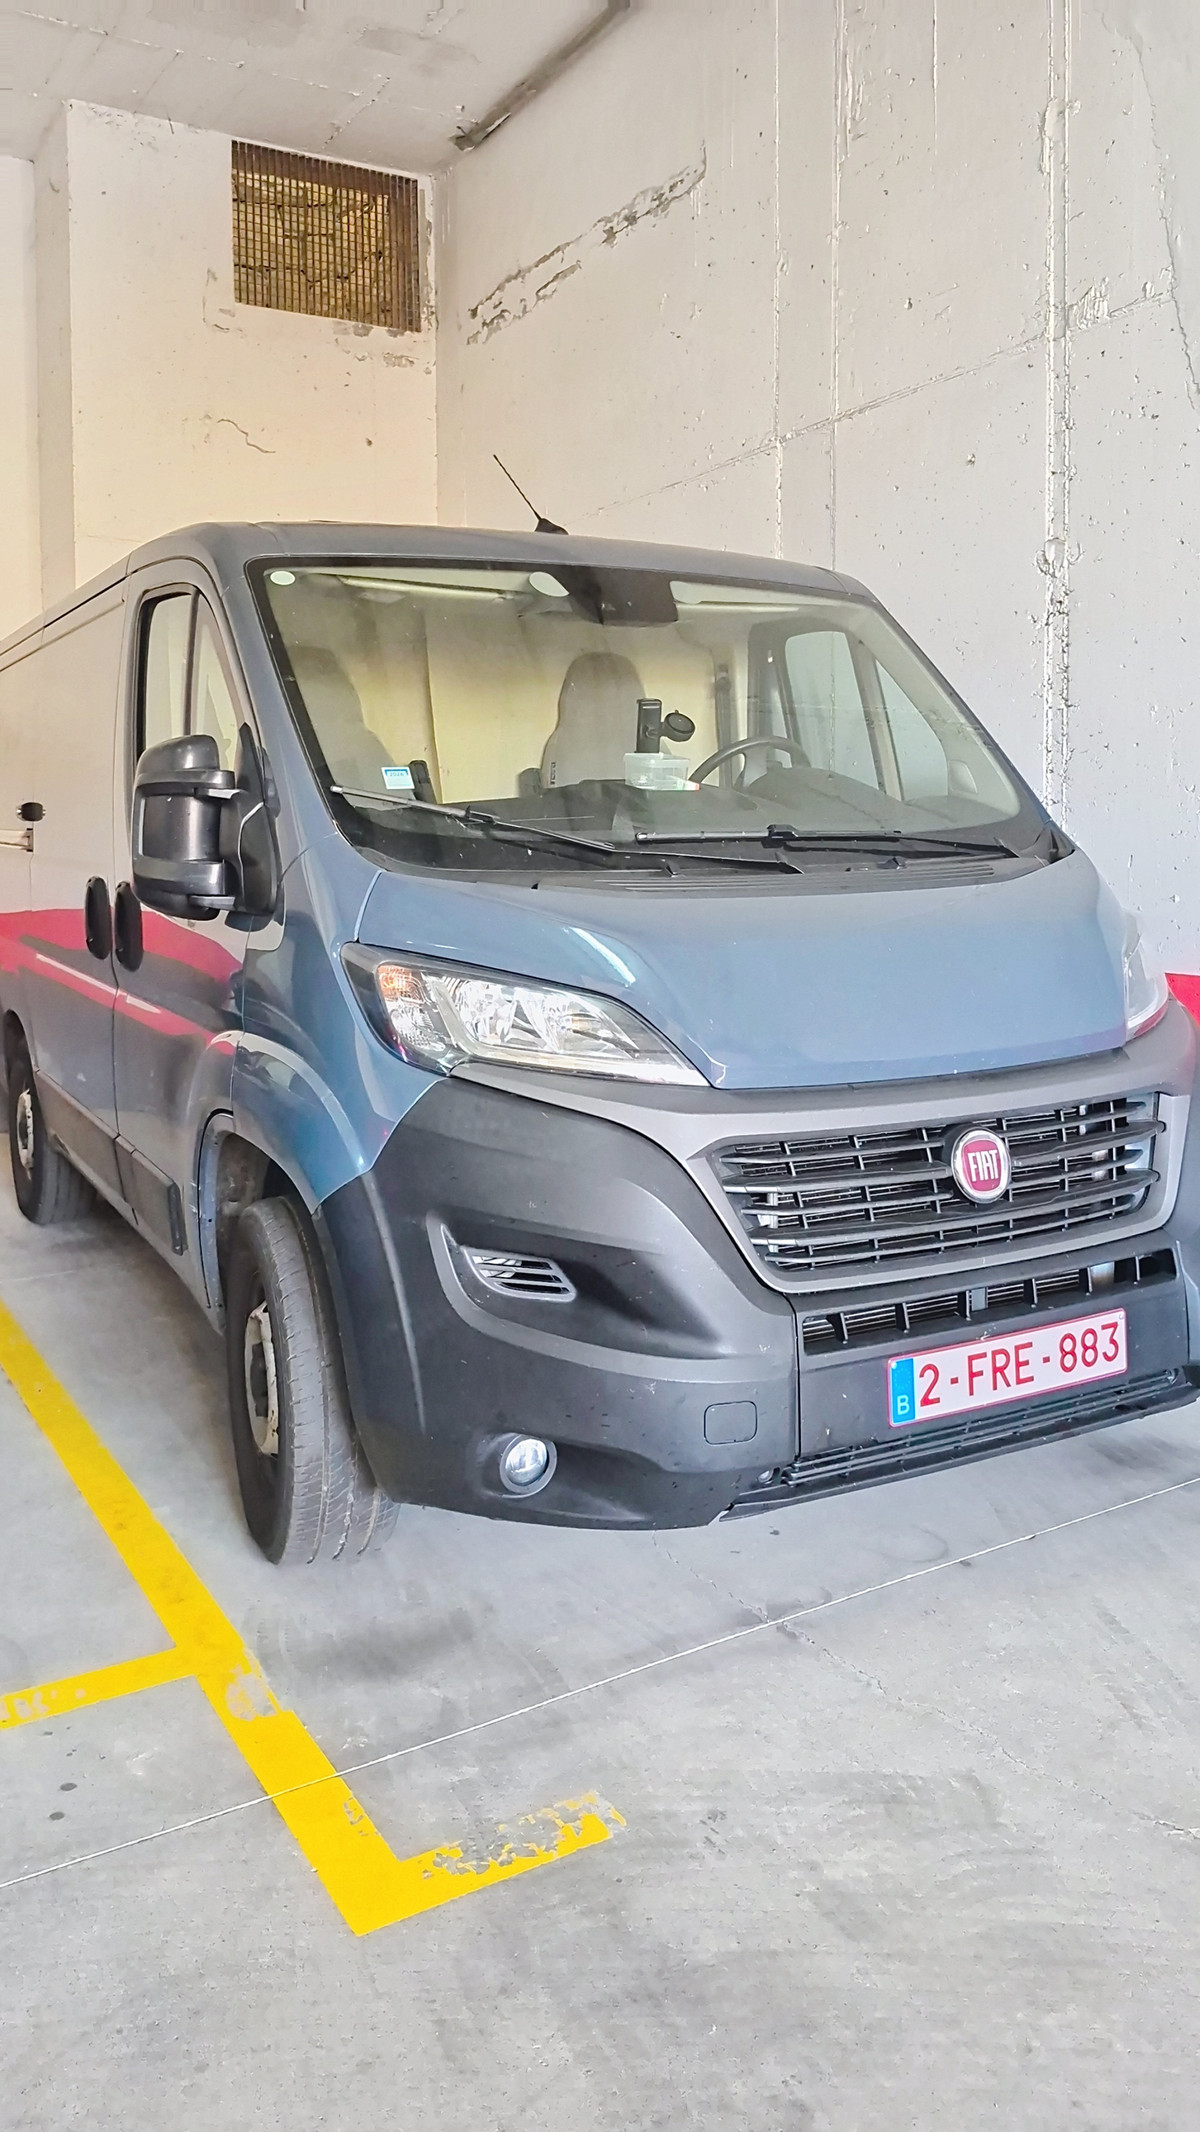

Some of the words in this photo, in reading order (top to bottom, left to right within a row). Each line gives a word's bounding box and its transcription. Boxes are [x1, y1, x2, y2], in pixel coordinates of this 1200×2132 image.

[968, 1150, 999, 1182] FIAT
[897, 1395, 910, 1415] B
[919, 1321, 1120, 1407] 2-FRE-883
